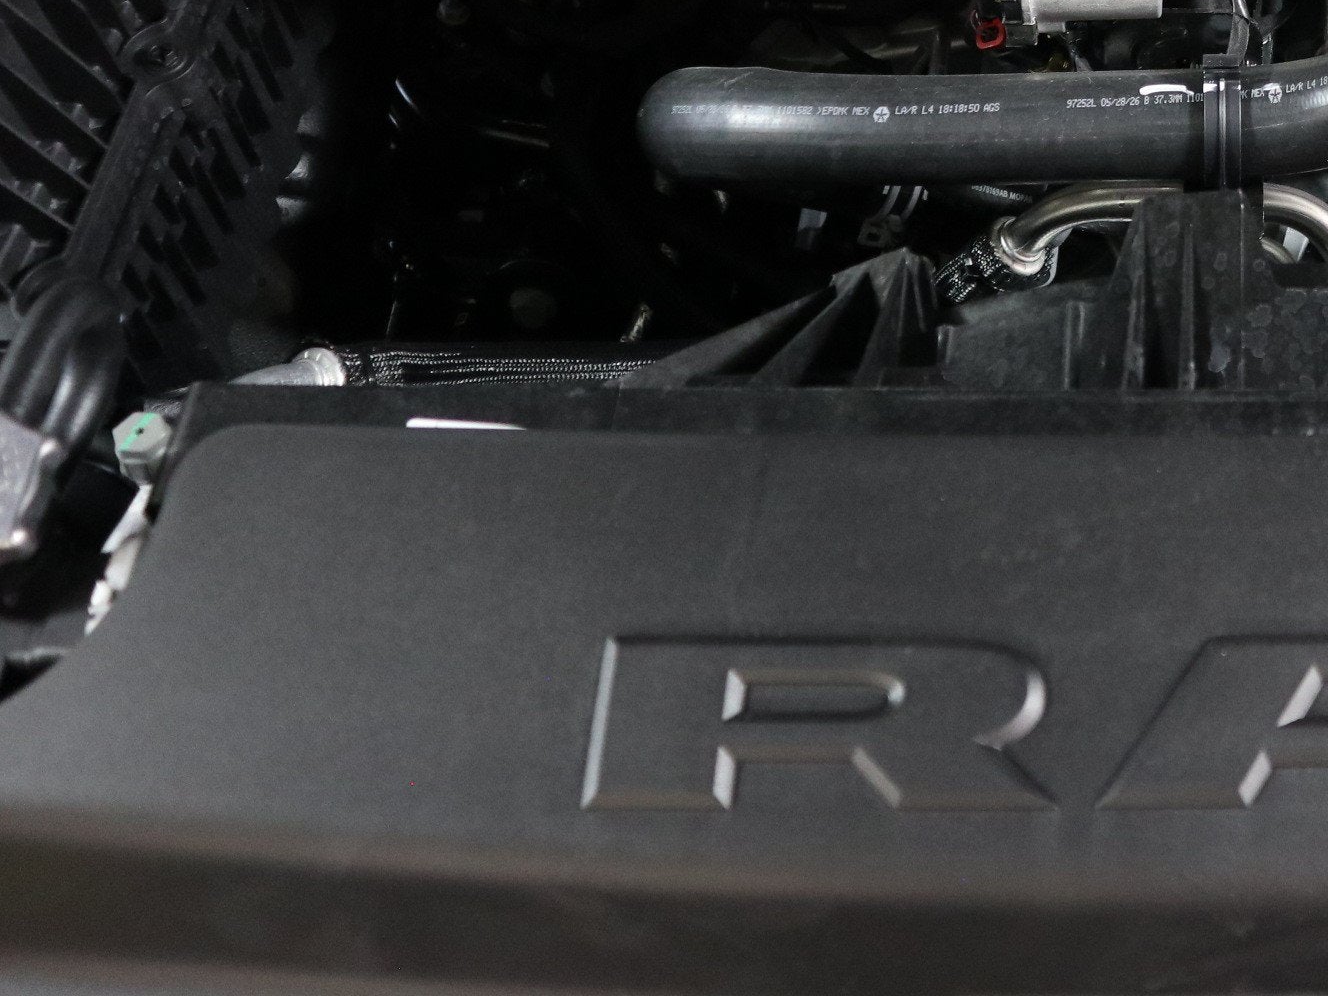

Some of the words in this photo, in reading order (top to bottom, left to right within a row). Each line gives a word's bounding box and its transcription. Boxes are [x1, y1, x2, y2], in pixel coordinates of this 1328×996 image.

[1066, 98, 1097, 109] 97252L
[1154, 94, 1183, 105] 37.3MM
[1306, 79, 1317, 91] L4
[852, 105, 870, 116] MEX
[894, 104, 917, 116] LA/R
[921, 104, 934, 115] L4
[938, 103, 980, 115] 18:18:50
[983, 102, 1001, 113] AGS
